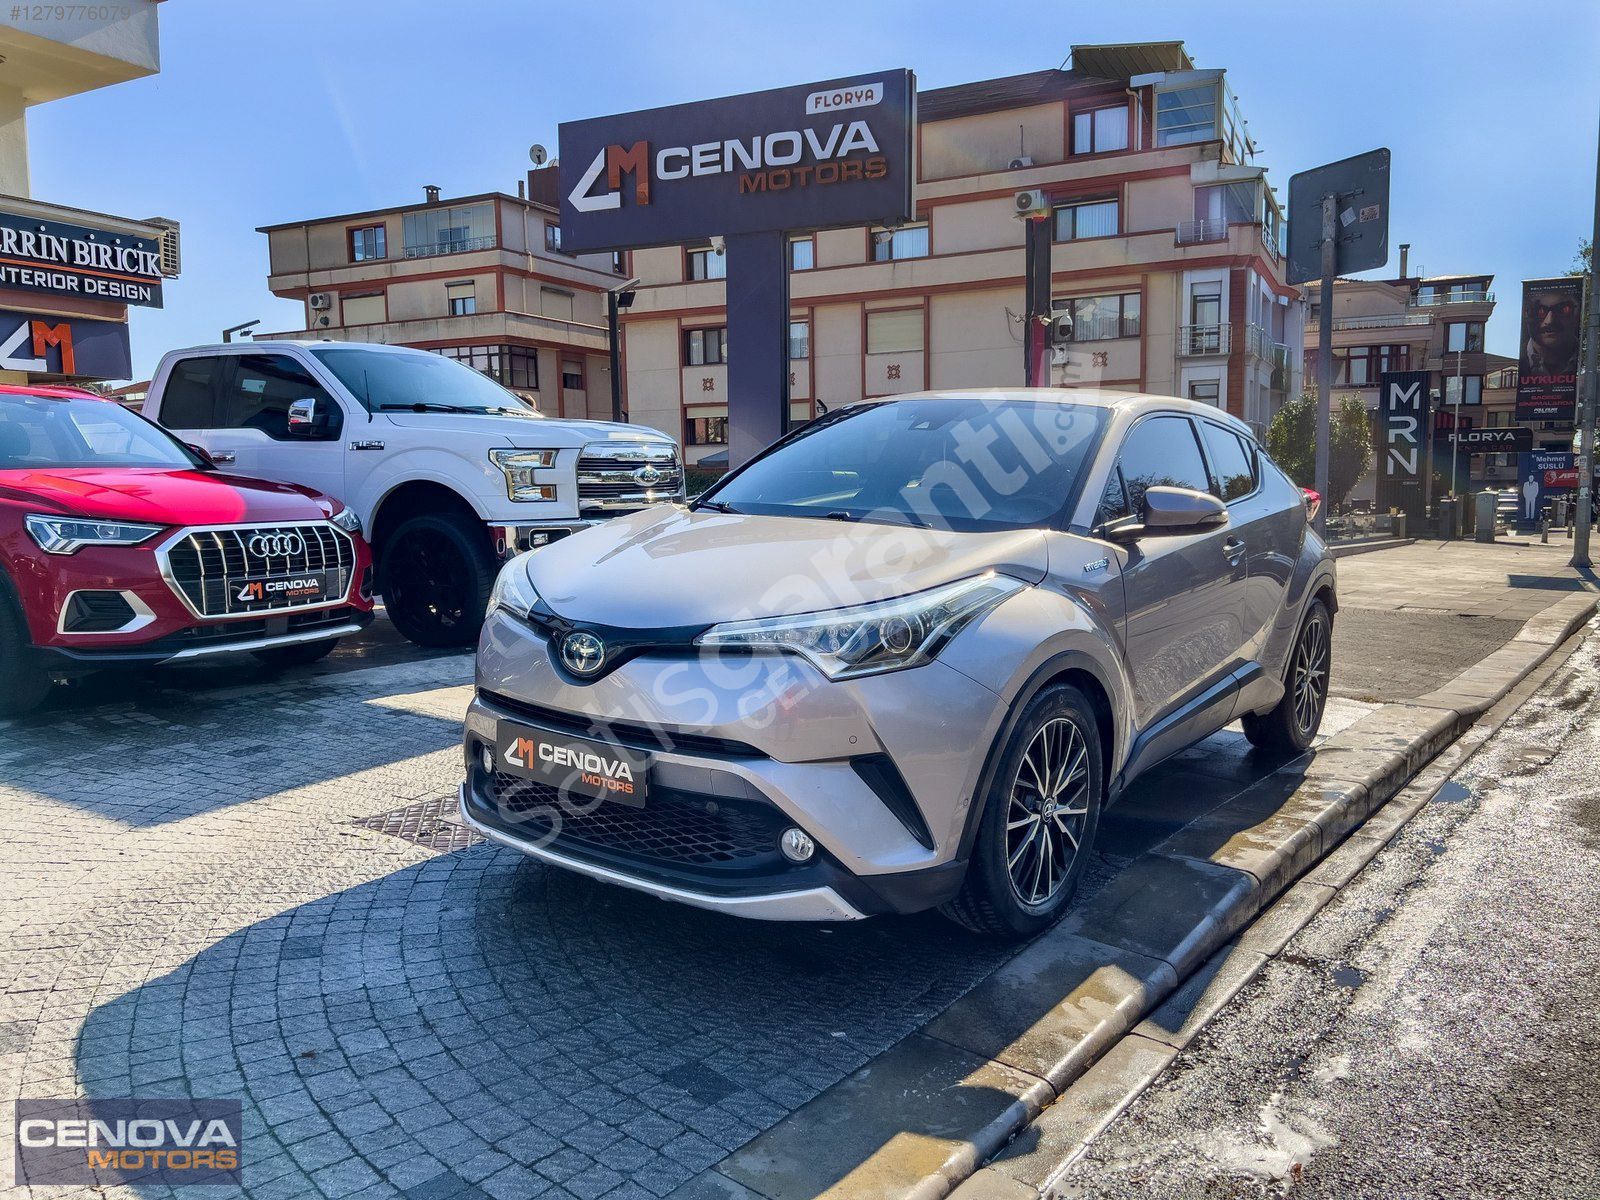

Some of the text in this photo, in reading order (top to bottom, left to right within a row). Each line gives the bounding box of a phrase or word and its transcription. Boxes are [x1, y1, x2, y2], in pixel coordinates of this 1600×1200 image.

[814, 88, 875, 109] FLORYA
[656, 120, 879, 181] CENOVA
[739, 156, 887, 194] MOTORS
[0, 225, 69, 263] RRİN
[84, 277, 151, 301] DESIGN
[1520, 375, 1575, 385] UYKUCU
[1448, 432, 1516, 442] FLORYA
[1536, 455, 1566, 463] Mehmet
[265, 578, 319, 592] CENOVA
[286, 588, 320, 596] MOTORS
[538, 743, 634, 782] CENOVA
[582, 773, 634, 794] MOTORS
